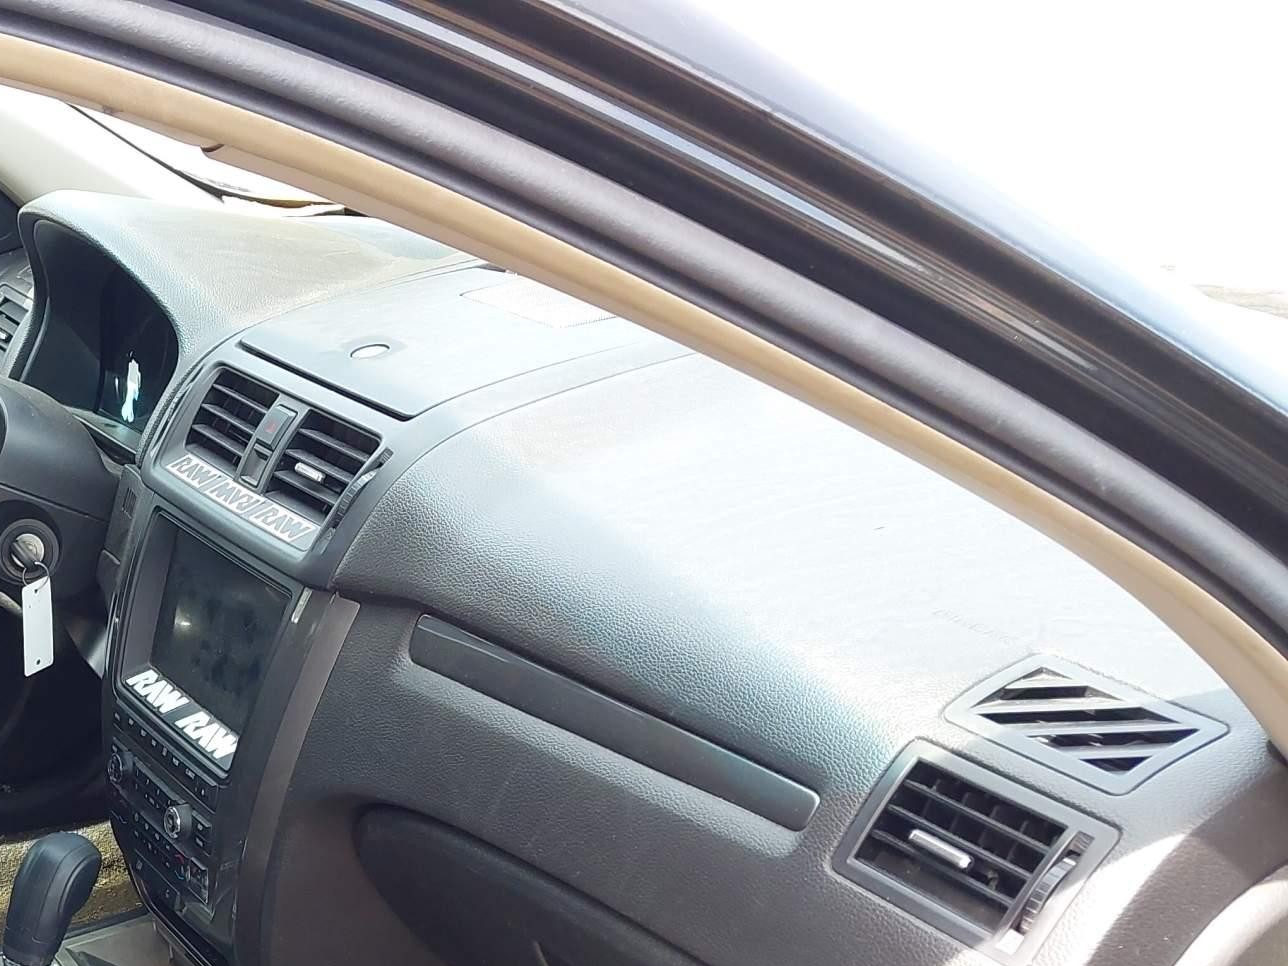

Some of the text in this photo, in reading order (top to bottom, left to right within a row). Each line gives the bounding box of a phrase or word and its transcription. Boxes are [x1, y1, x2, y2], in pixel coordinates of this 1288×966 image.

[170, 455, 218, 486] RAW
[253, 506, 311, 539] RAW
[125, 669, 239, 760] RAW RAW
